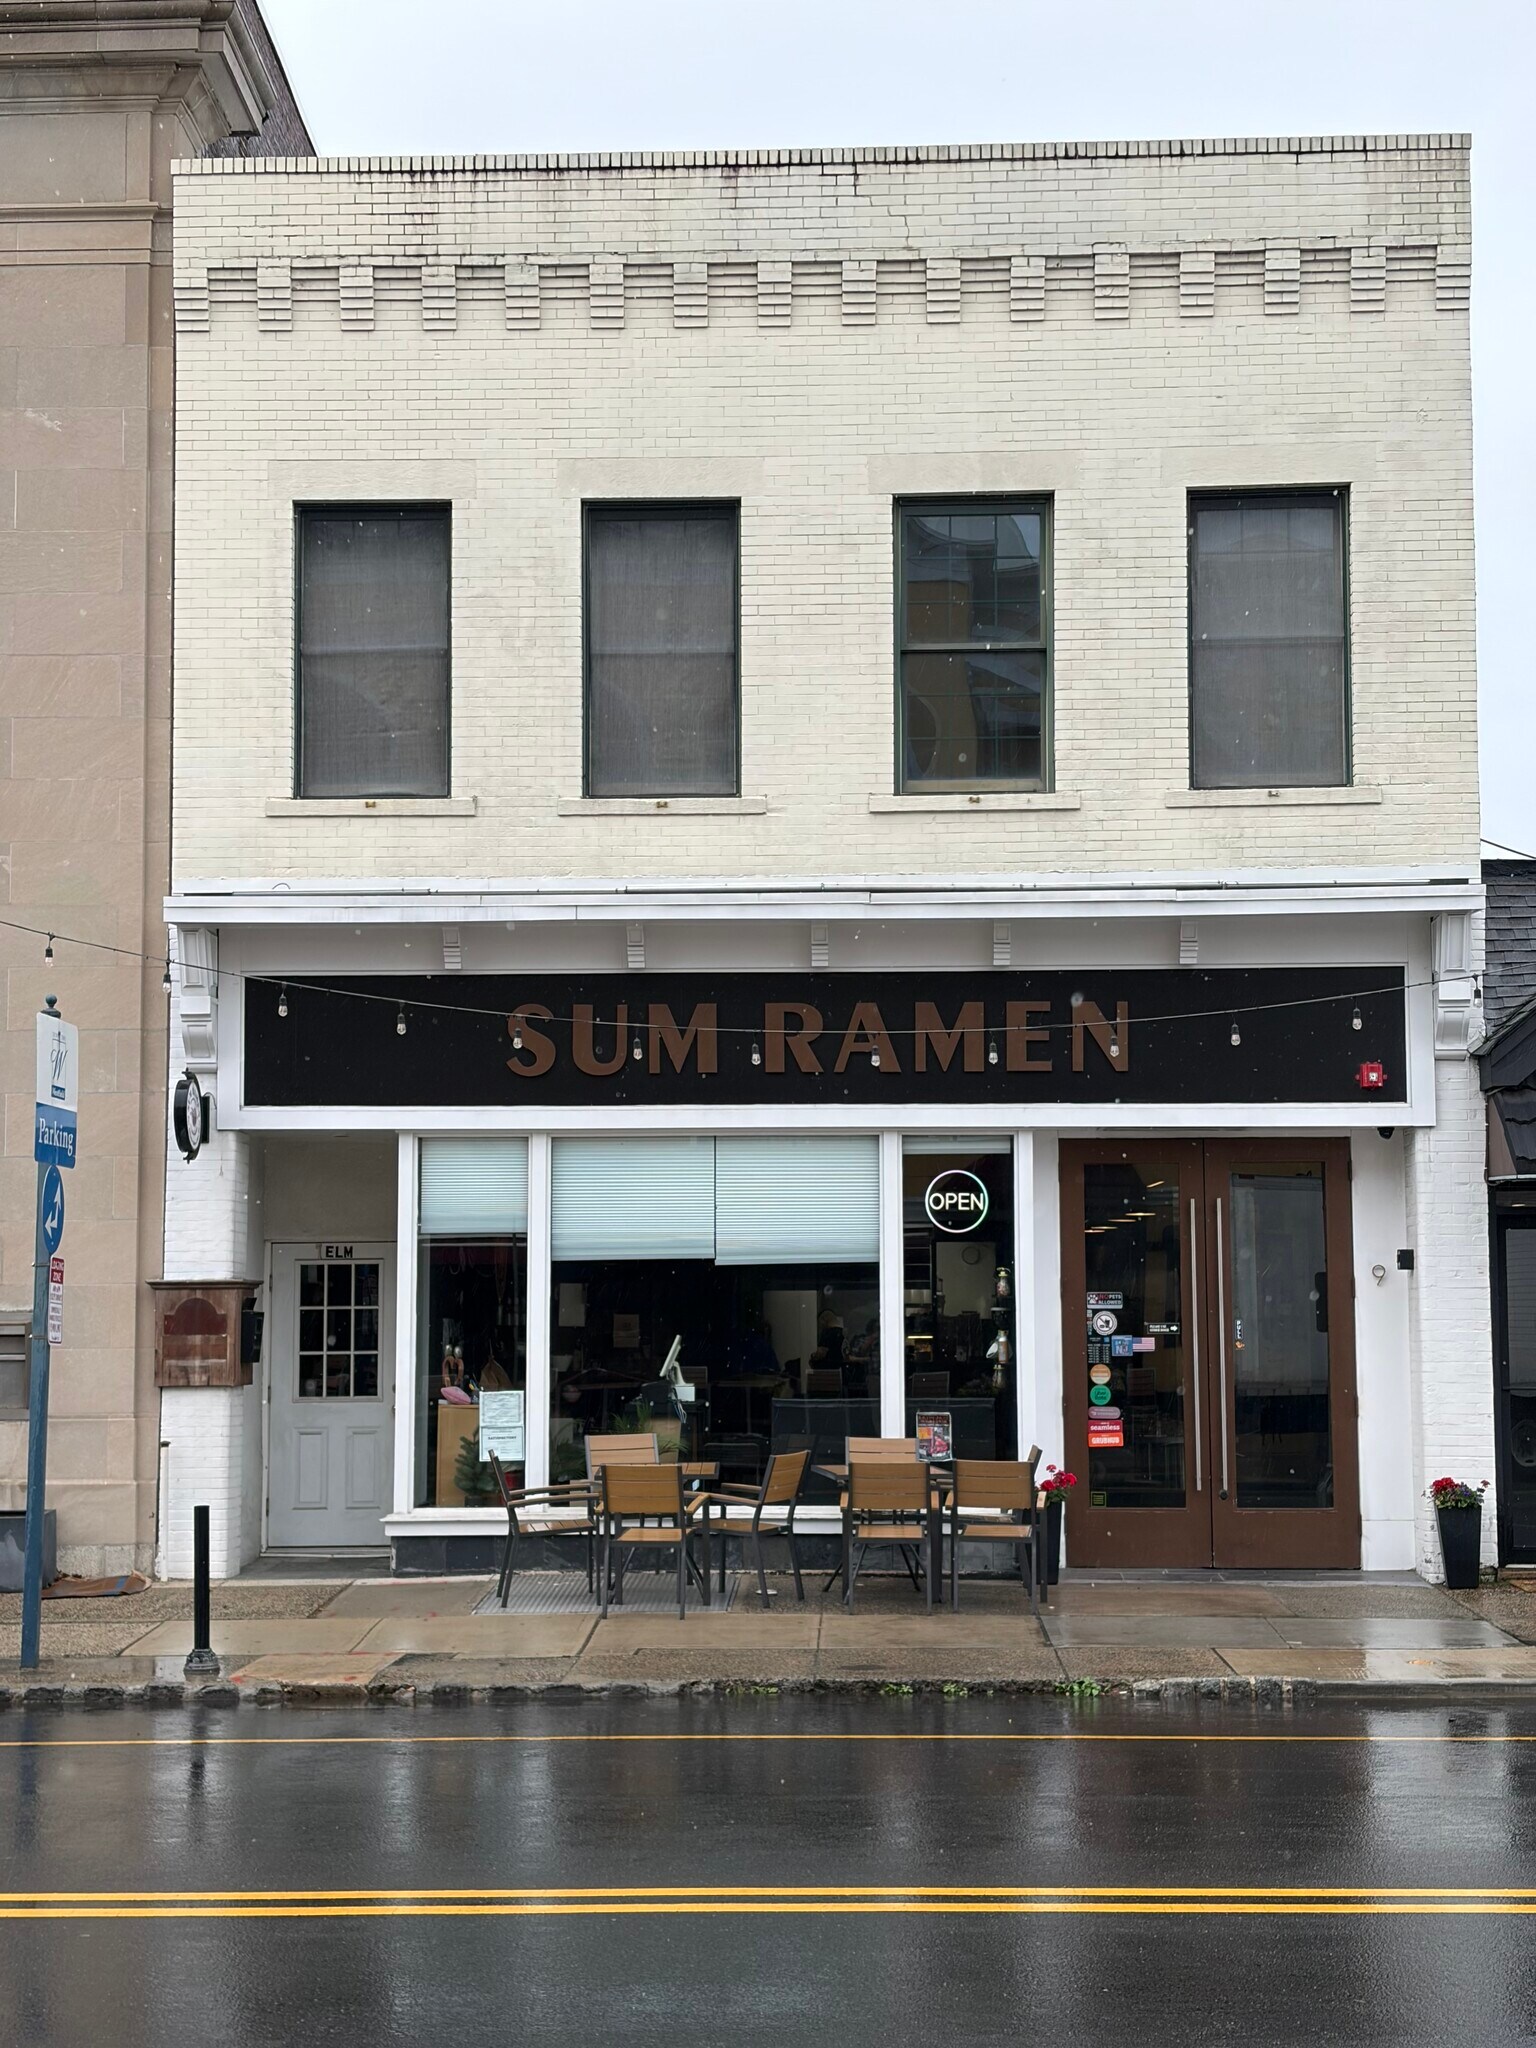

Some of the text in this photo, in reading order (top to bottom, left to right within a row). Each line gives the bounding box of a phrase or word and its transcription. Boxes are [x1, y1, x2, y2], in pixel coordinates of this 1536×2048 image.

[506, 1001, 1129, 1077] SUM RAMEN
[38, 1117, 74, 1157] Parking
[929, 1192, 984, 1211] OPEN
[326, 1245, 353, 1258] ELM
